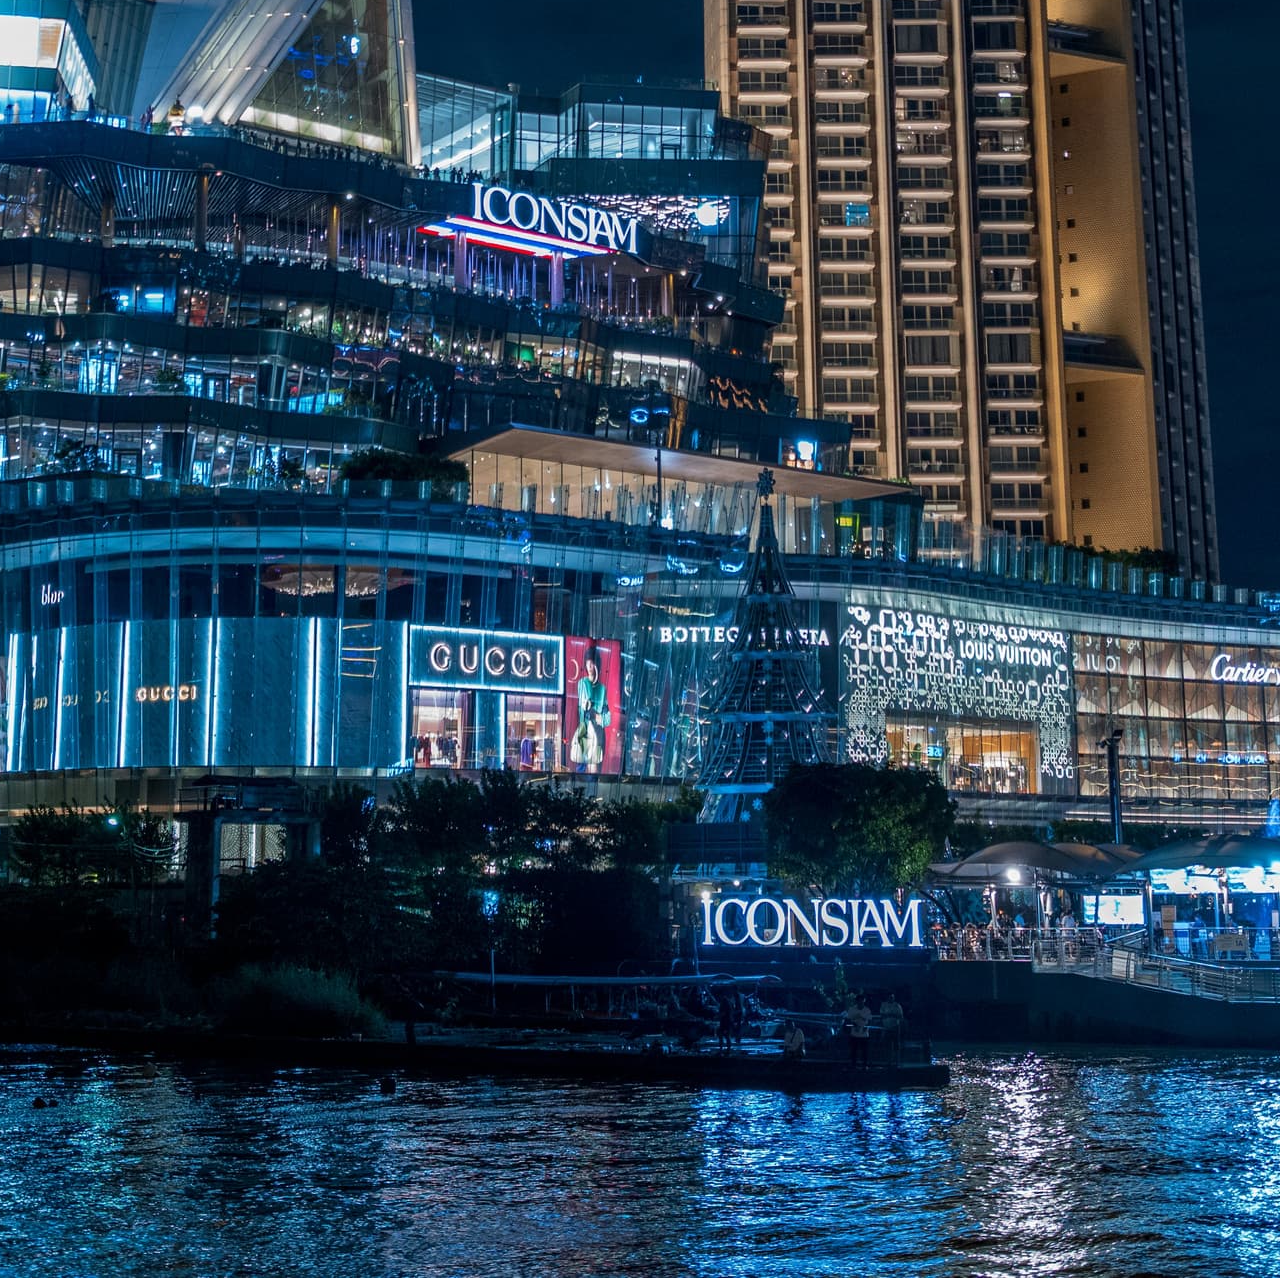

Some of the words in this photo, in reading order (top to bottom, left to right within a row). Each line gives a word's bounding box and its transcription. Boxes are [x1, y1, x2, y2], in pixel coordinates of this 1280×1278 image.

[472, 182, 639, 254] ICONSIAM
[660, 626, 752, 644] BOTTEG
[430, 642, 543, 679] GUCCI
[960, 639, 994, 662] LOUIS
[997, 643, 1052, 668] VUITTON
[1210, 653, 1275, 685] Cartier
[135, 685, 198, 702] GUCCI
[701, 897, 924, 947] ICONSIAM
